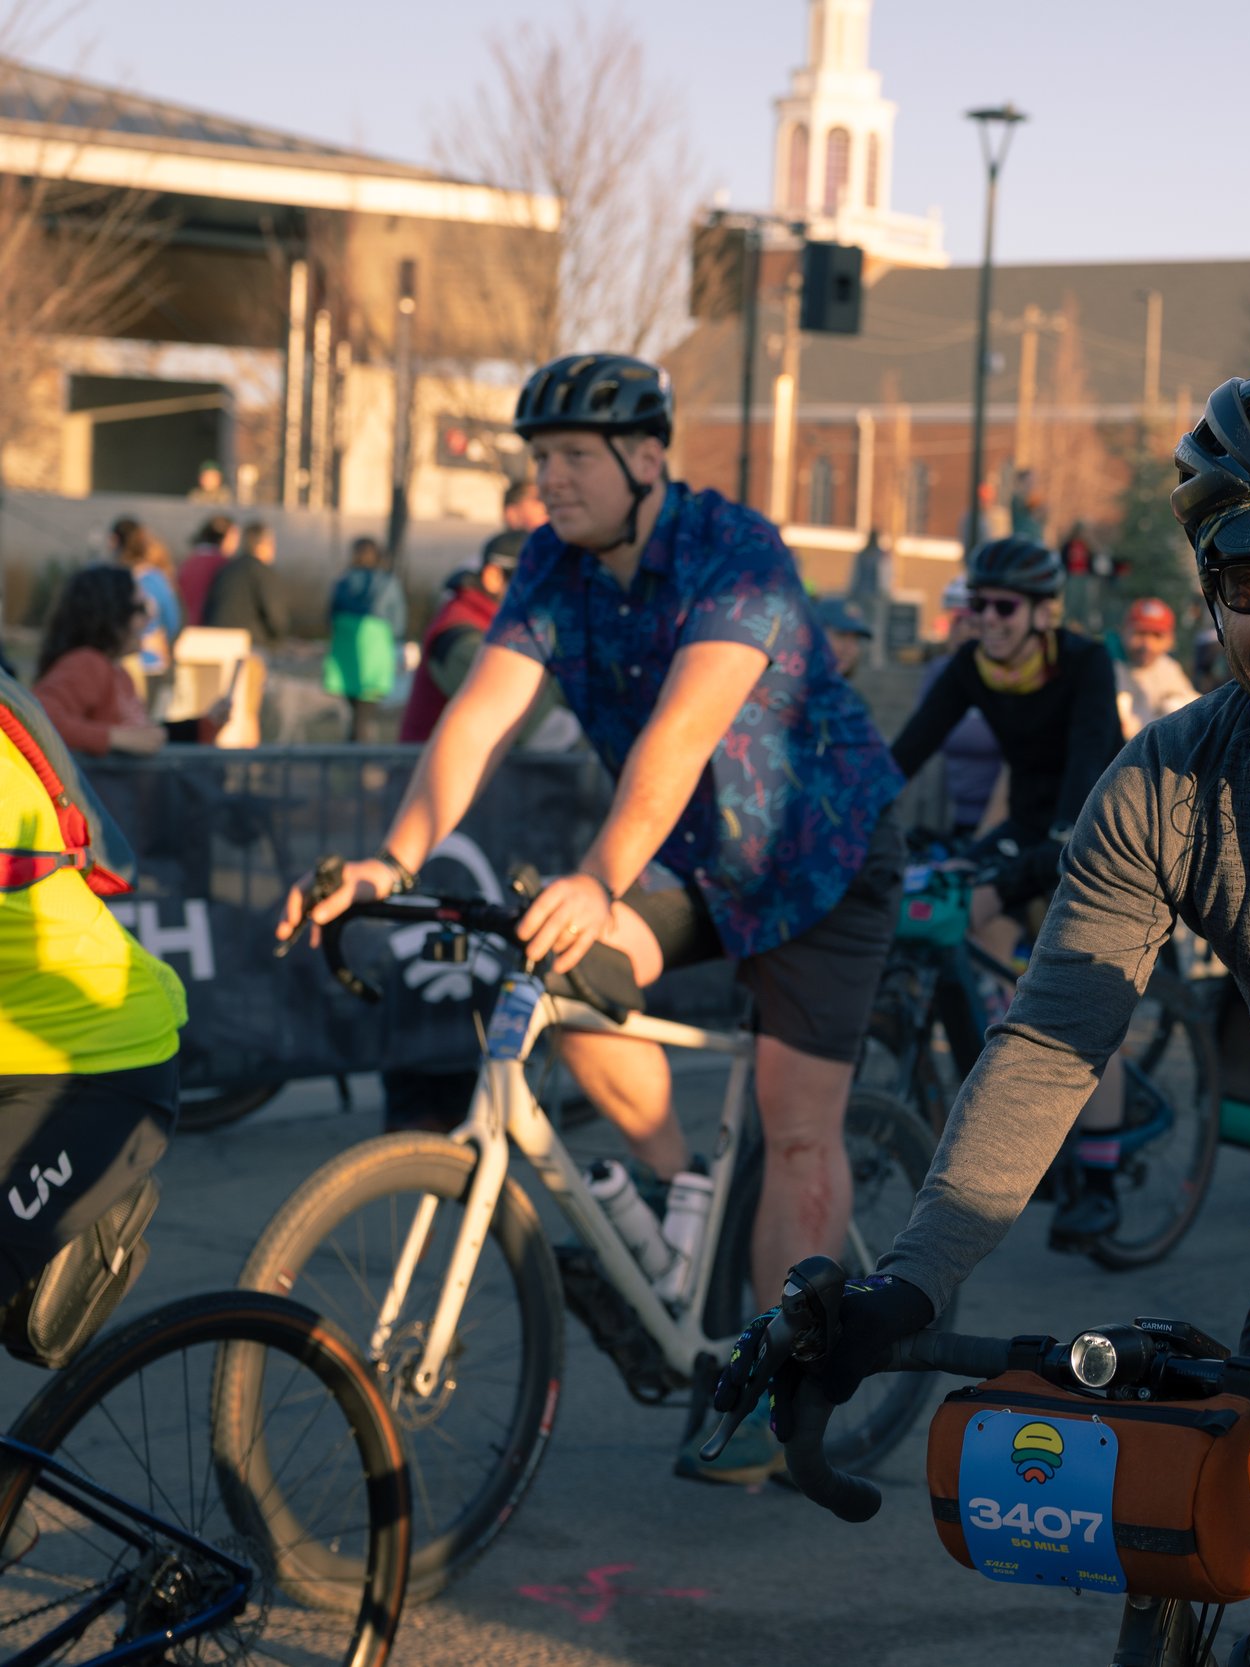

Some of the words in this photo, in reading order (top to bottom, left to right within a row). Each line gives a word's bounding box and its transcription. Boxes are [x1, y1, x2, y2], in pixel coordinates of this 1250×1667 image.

[8, 1149, 73, 1220] Liv
[1141, 1321, 1172, 1332] GARMIN
[968, 1497, 1103, 1543] 3407
[1011, 1538, 1032, 1550] 50
[1034, 1540, 1069, 1554] MILE
